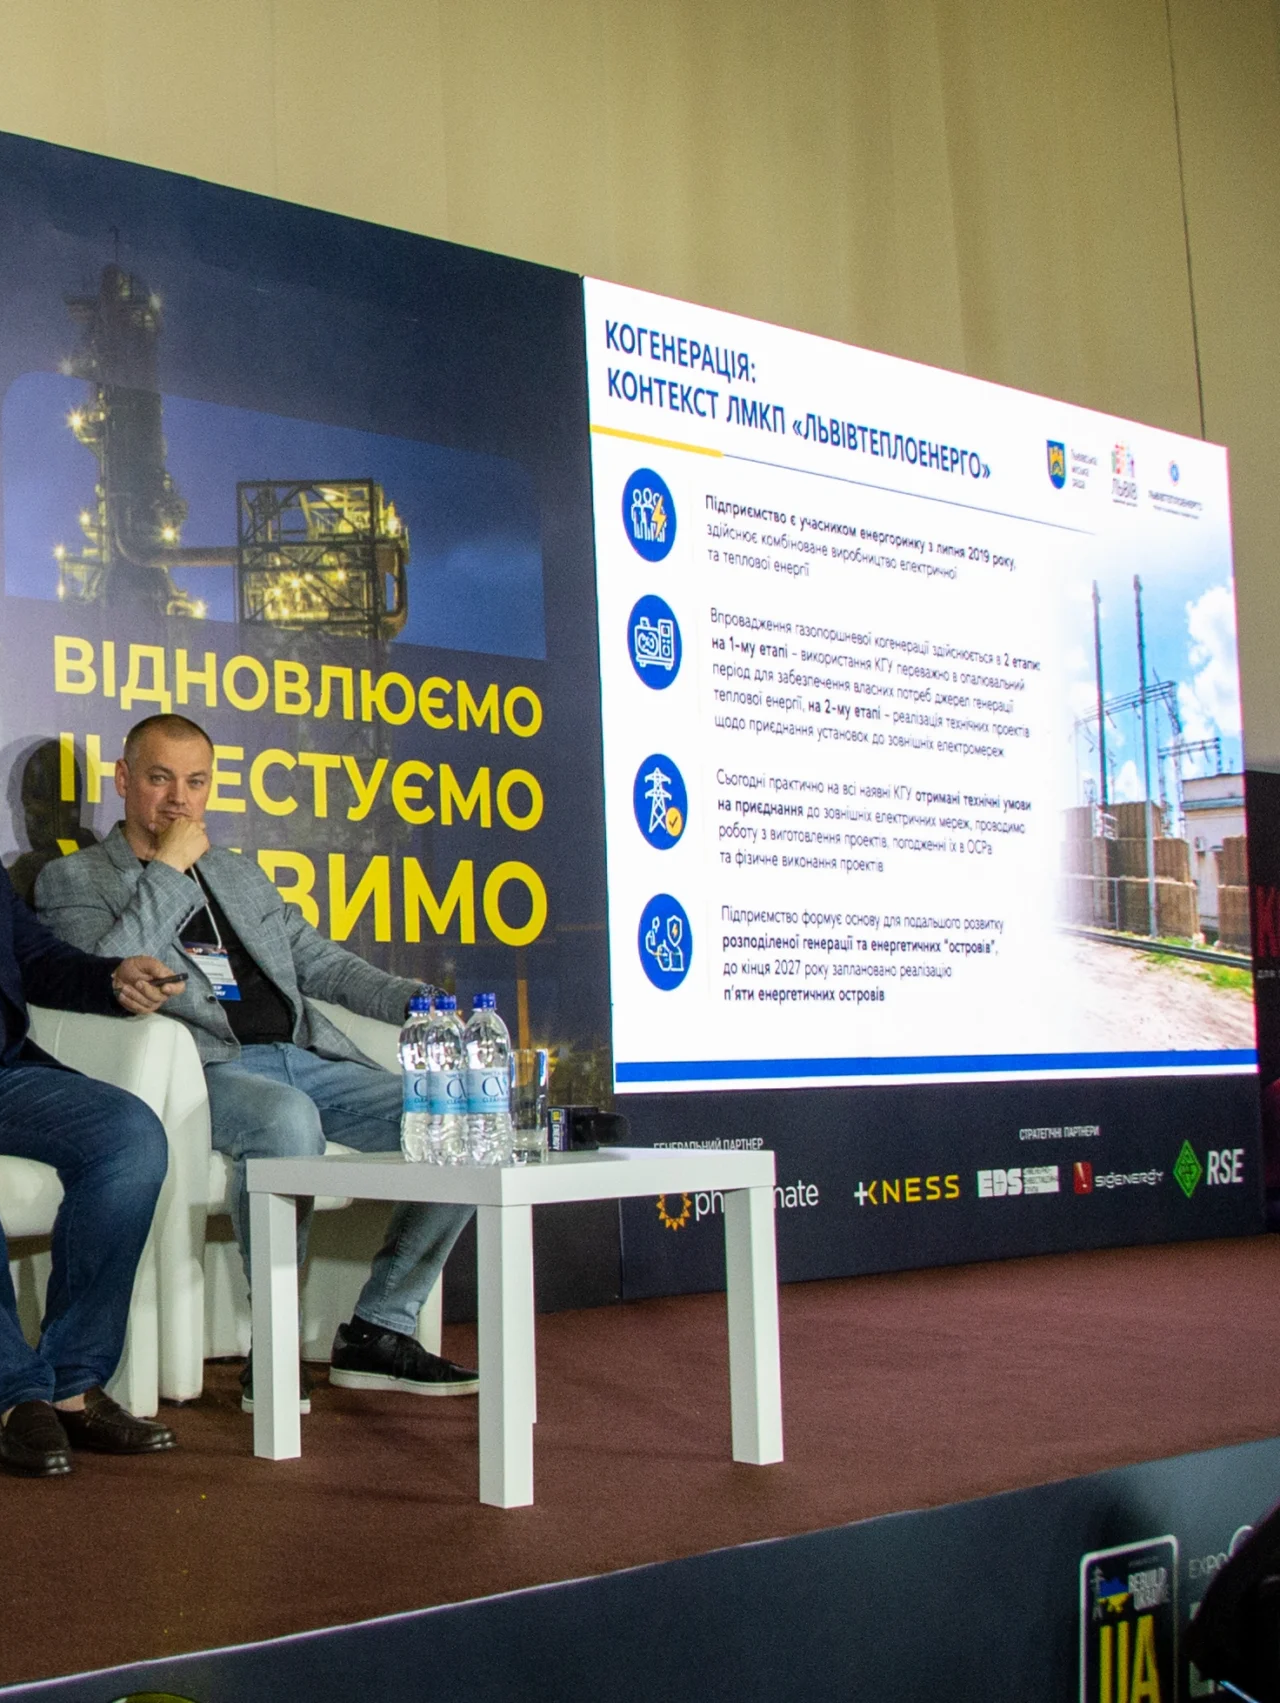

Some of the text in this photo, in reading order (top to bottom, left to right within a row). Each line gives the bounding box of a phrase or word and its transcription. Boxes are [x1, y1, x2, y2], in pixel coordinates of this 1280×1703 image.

[605, 319, 756, 383] КОГЕНЕРАЦІЯ:
[608, 367, 991, 479] КОНТЕКСТ ЛМКП «ЛЬВІВТЕПЛОЕНЕРГО»
[705, 494, 787, 524] Підприємство
[790, 514, 796, 526] є
[800, 516, 857, 536] учасником
[860, 528, 925, 554] енергоринку
[928, 541, 934, 553] з
[936, 543, 966, 558] липня
[968, 546, 990, 563] 2019
[707, 522, 958, 580] здійснює комбіноване виробництво електричної
[708, 549, 810, 578] та теплової енергії
[710, 607, 792, 633] Впровадження
[796, 624, 871, 645] газопоршневої
[875, 635, 929, 655] когенерації
[932, 644, 993, 664] здійснюється
[1004, 653, 1009, 667] 2
[712, 637, 725, 650] на
[729, 636, 755, 658] 1-му
[760, 644, 788, 658] етапі
[801, 649, 872, 670] використання
[874, 656, 893, 673] КГУ
[897, 663, 949, 681] переважно
[53, 634, 544, 739] ВІДНОВЛЮЄМО
[713, 662, 751, 681] період
[754, 668, 774, 682] для
[777, 669, 851, 691] забезпечення
[853, 682, 894, 697] власних
[897, 687, 932, 705] потреб
[714, 688, 762, 706] теплової
[808, 701, 821, 713] на
[825, 699, 850, 721] 2-му
[854, 705, 881, 720] етапі
[893, 710, 943, 728] реалізація
[946, 717, 989, 733] технічних
[992, 723, 1030, 738] проектів
[715, 715, 746, 730] щодо
[749, 718, 814, 737] приєднання
[817, 725, 869, 743] установок
[872, 733, 885, 745] до
[888, 735, 934, 750] зовнішніх
[59, 732, 544, 832] ІНЕСТУЄМО
[716, 768, 1032, 813] Сьогодні практично на всі наявні КГУ отримані технічні умови
[718, 799, 731, 811] на
[735, 800, 803, 817] приєднання
[807, 806, 820, 819] до
[824, 805, 872, 822] зовнішніх
[875, 811, 936, 829] електричних
[976, 819, 1025, 835] проводимо
[719, 822, 758, 844] роботу
[761, 828, 767, 841] з
[771, 829, 841, 844] виготовлення
[959, 842, 965, 854] в
[720, 848, 884, 873] та фізичне виконання проектів
[56, 838, 548, 947] ВИМО
[721, 905, 1004, 934] Підприємство формує основу для подальшого розвитку
[722, 933, 800, 952] розподіленої
[803, 935, 853, 954] генерації
[856, 940, 867, 950] та
[871, 940, 941, 956] енергетичних
[723, 958, 952, 980] до кінця 2027 року заплановано реалізацію
[758, 988, 835, 1005] енергетичних
[839, 986, 885, 1005] островів
[723, 1138, 763, 1150] ПАРТНЕР
[1019, 1125, 1100, 1141] СТРАТЕГІЧНІ ПАРТНЕРИ
[977, 1168, 1022, 1197] EDS
[1207, 1149, 1244, 1185] RSE
[1100, 1614, 1161, 1703] UA
